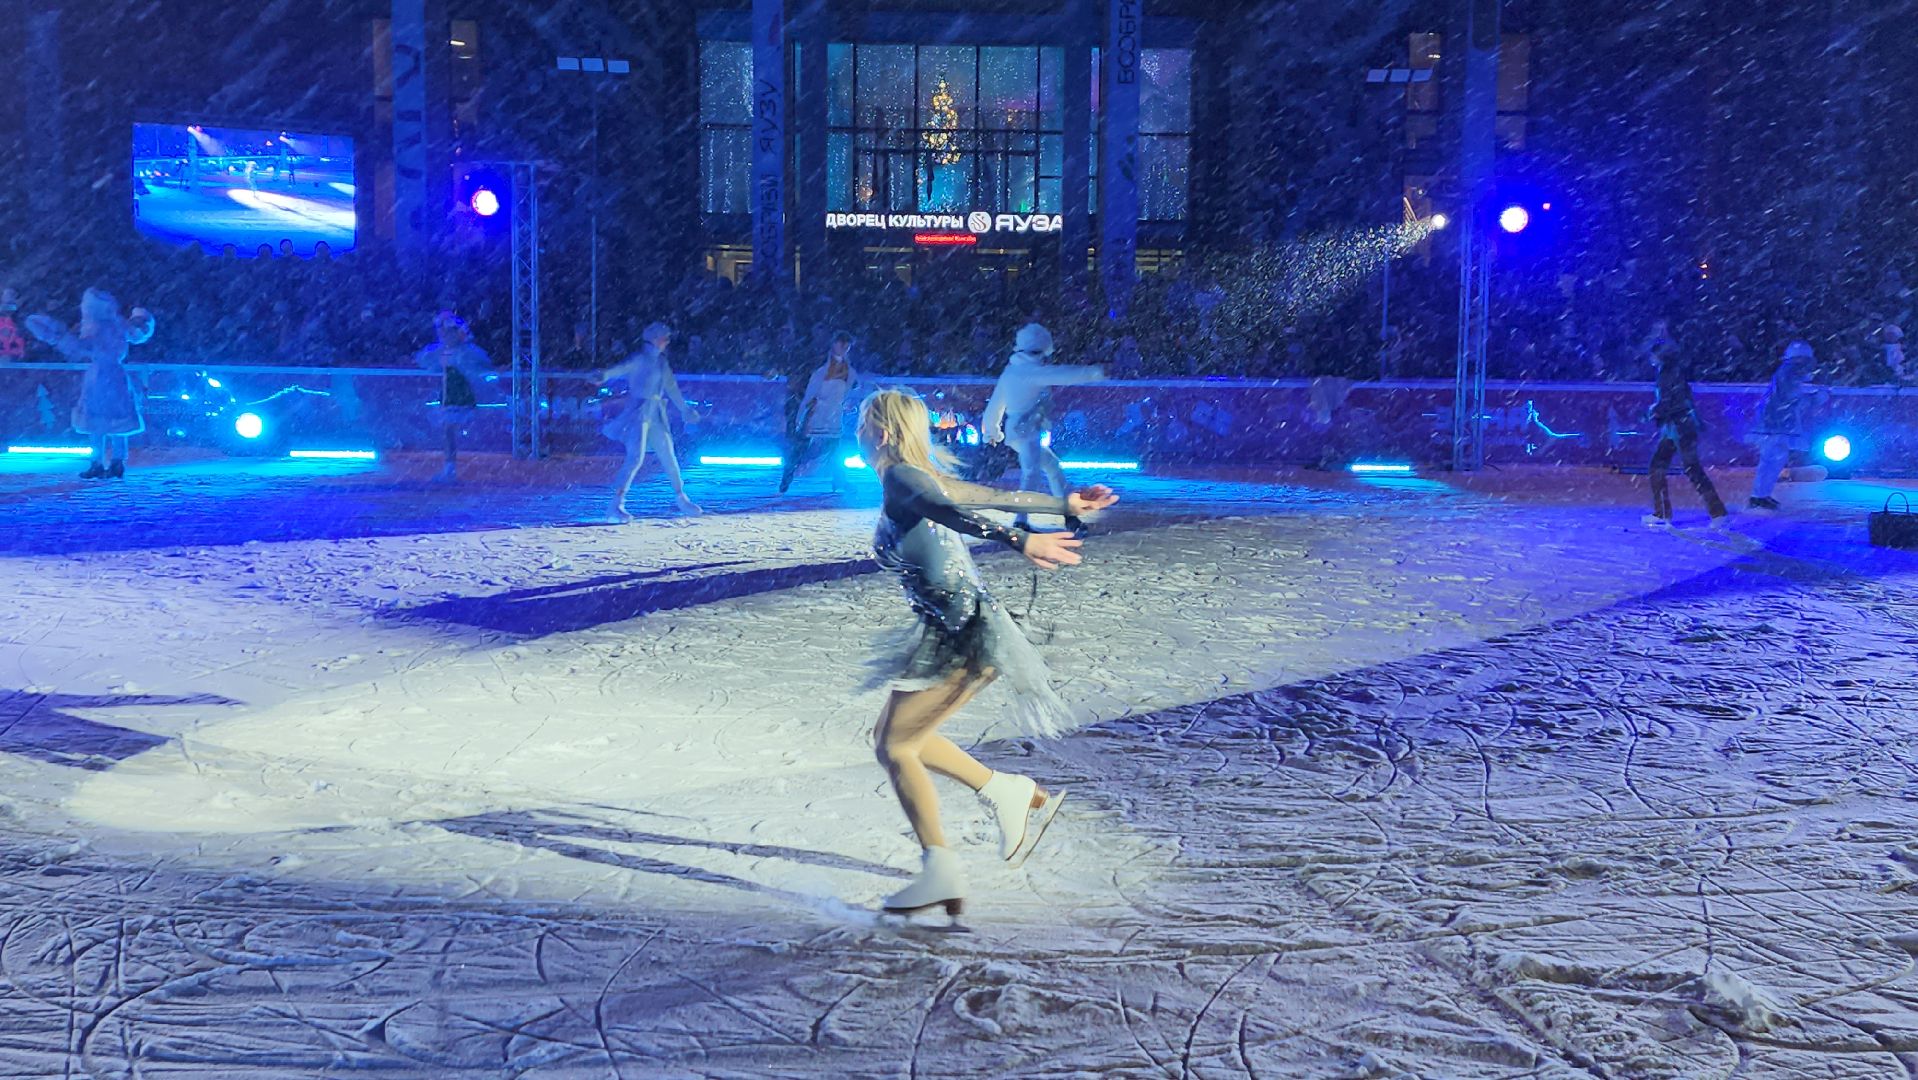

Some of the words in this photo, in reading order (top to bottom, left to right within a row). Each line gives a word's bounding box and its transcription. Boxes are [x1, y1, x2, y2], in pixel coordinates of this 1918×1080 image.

[759, 79, 779, 154] ЯУЗУ
[826, 213, 886, 229] ДВОРЕЦ
[888, 213, 964, 229] КУЛЬТУРЫ
[995, 214, 1063, 232] ЯУЗА
